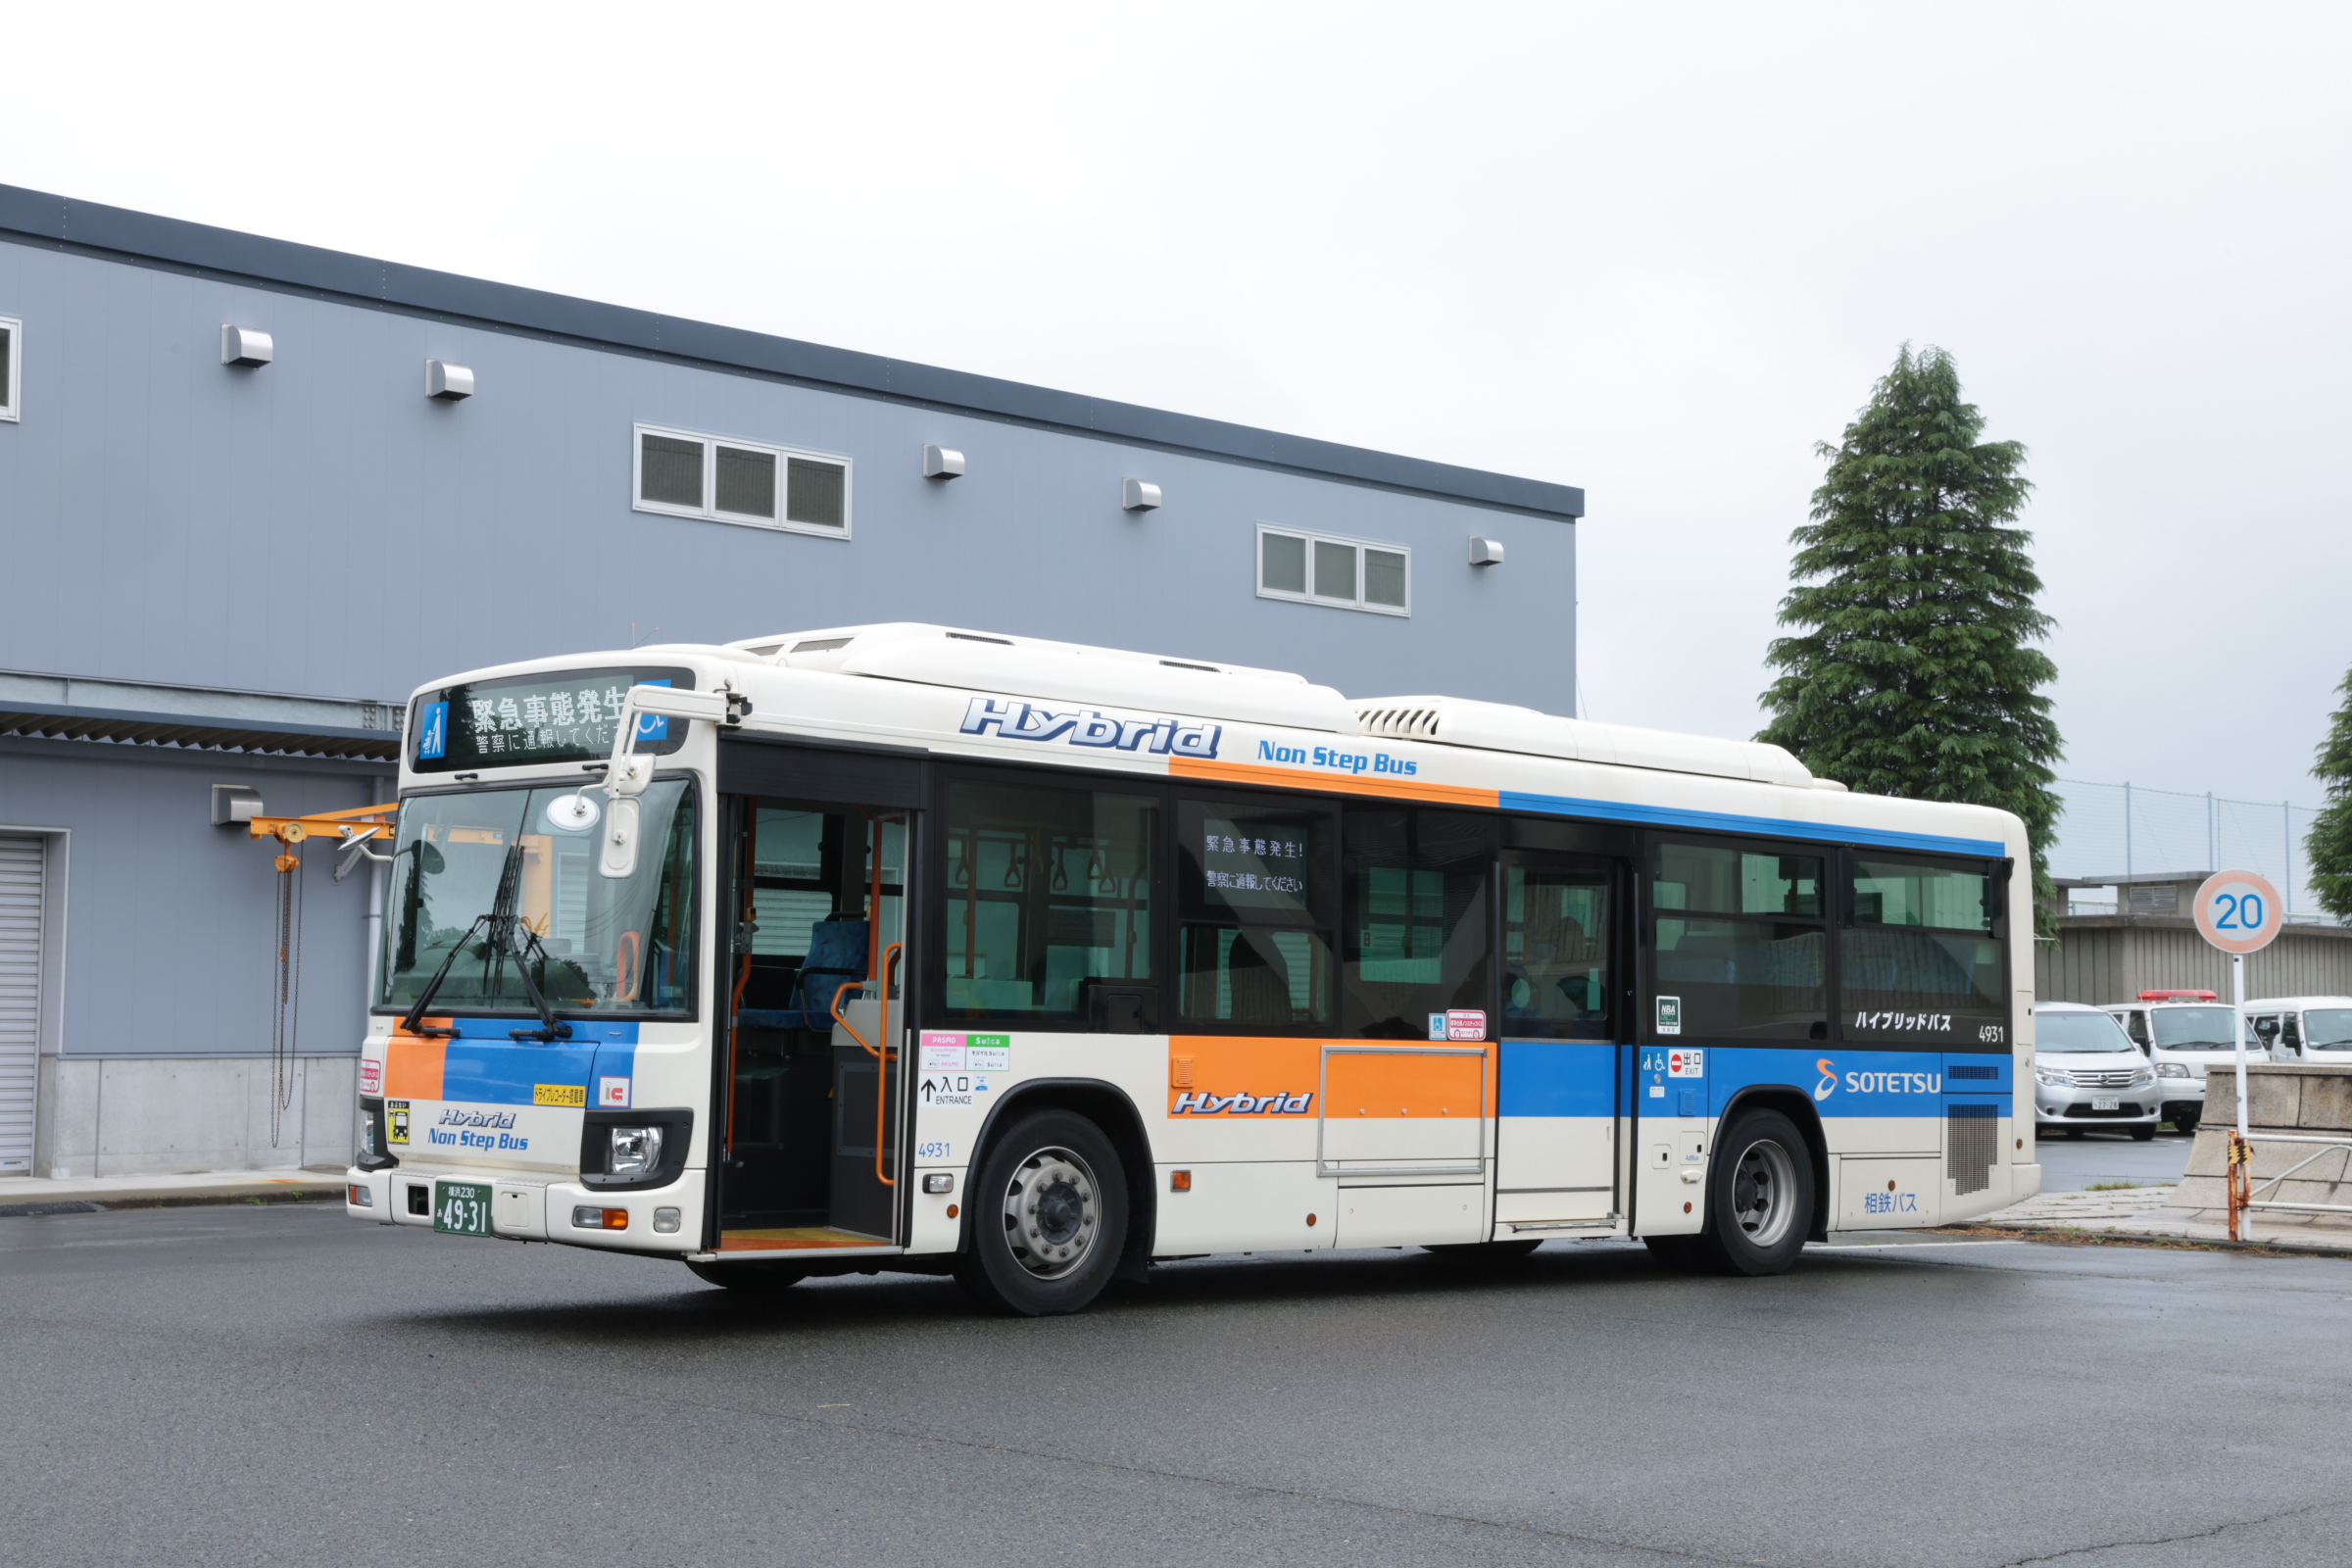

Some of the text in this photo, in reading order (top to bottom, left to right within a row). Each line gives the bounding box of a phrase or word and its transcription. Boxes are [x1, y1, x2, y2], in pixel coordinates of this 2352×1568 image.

[472, 686, 633, 734] 緊急事態発生
[475, 723, 629, 755] 警察に通報してくだ
[959, 697, 1223, 760] Hybrid
[1258, 740, 1418, 776] Non Step Bus
[1206, 835, 1302, 858] 緊急事態発生!
[1206, 870, 1302, 893] 警察に通報してください
[2215, 894, 2263, 929] 20
[1661, 1004, 1675, 1015] NBA
[1855, 1011, 1951, 1032] ハイブリッドバス
[1979, 1025, 2004, 1043] 4931
[1683, 1053, 1701, 1065] 出口
[941, 1076, 968, 1093] 入口
[1845, 1071, 1941, 1094] SOTETSU
[936, 1096, 972, 1105] ENTRANCE
[1171, 1092, 1314, 1114] Hybrid
[438, 1109, 516, 1129] Hybrid
[428, 1128, 529, 1152] Non Step Bus
[918, 1143, 951, 1157] 4931
[1864, 1192, 1918, 1214] 相鉄バス
[437, 1199, 486, 1233] あ 49-31
